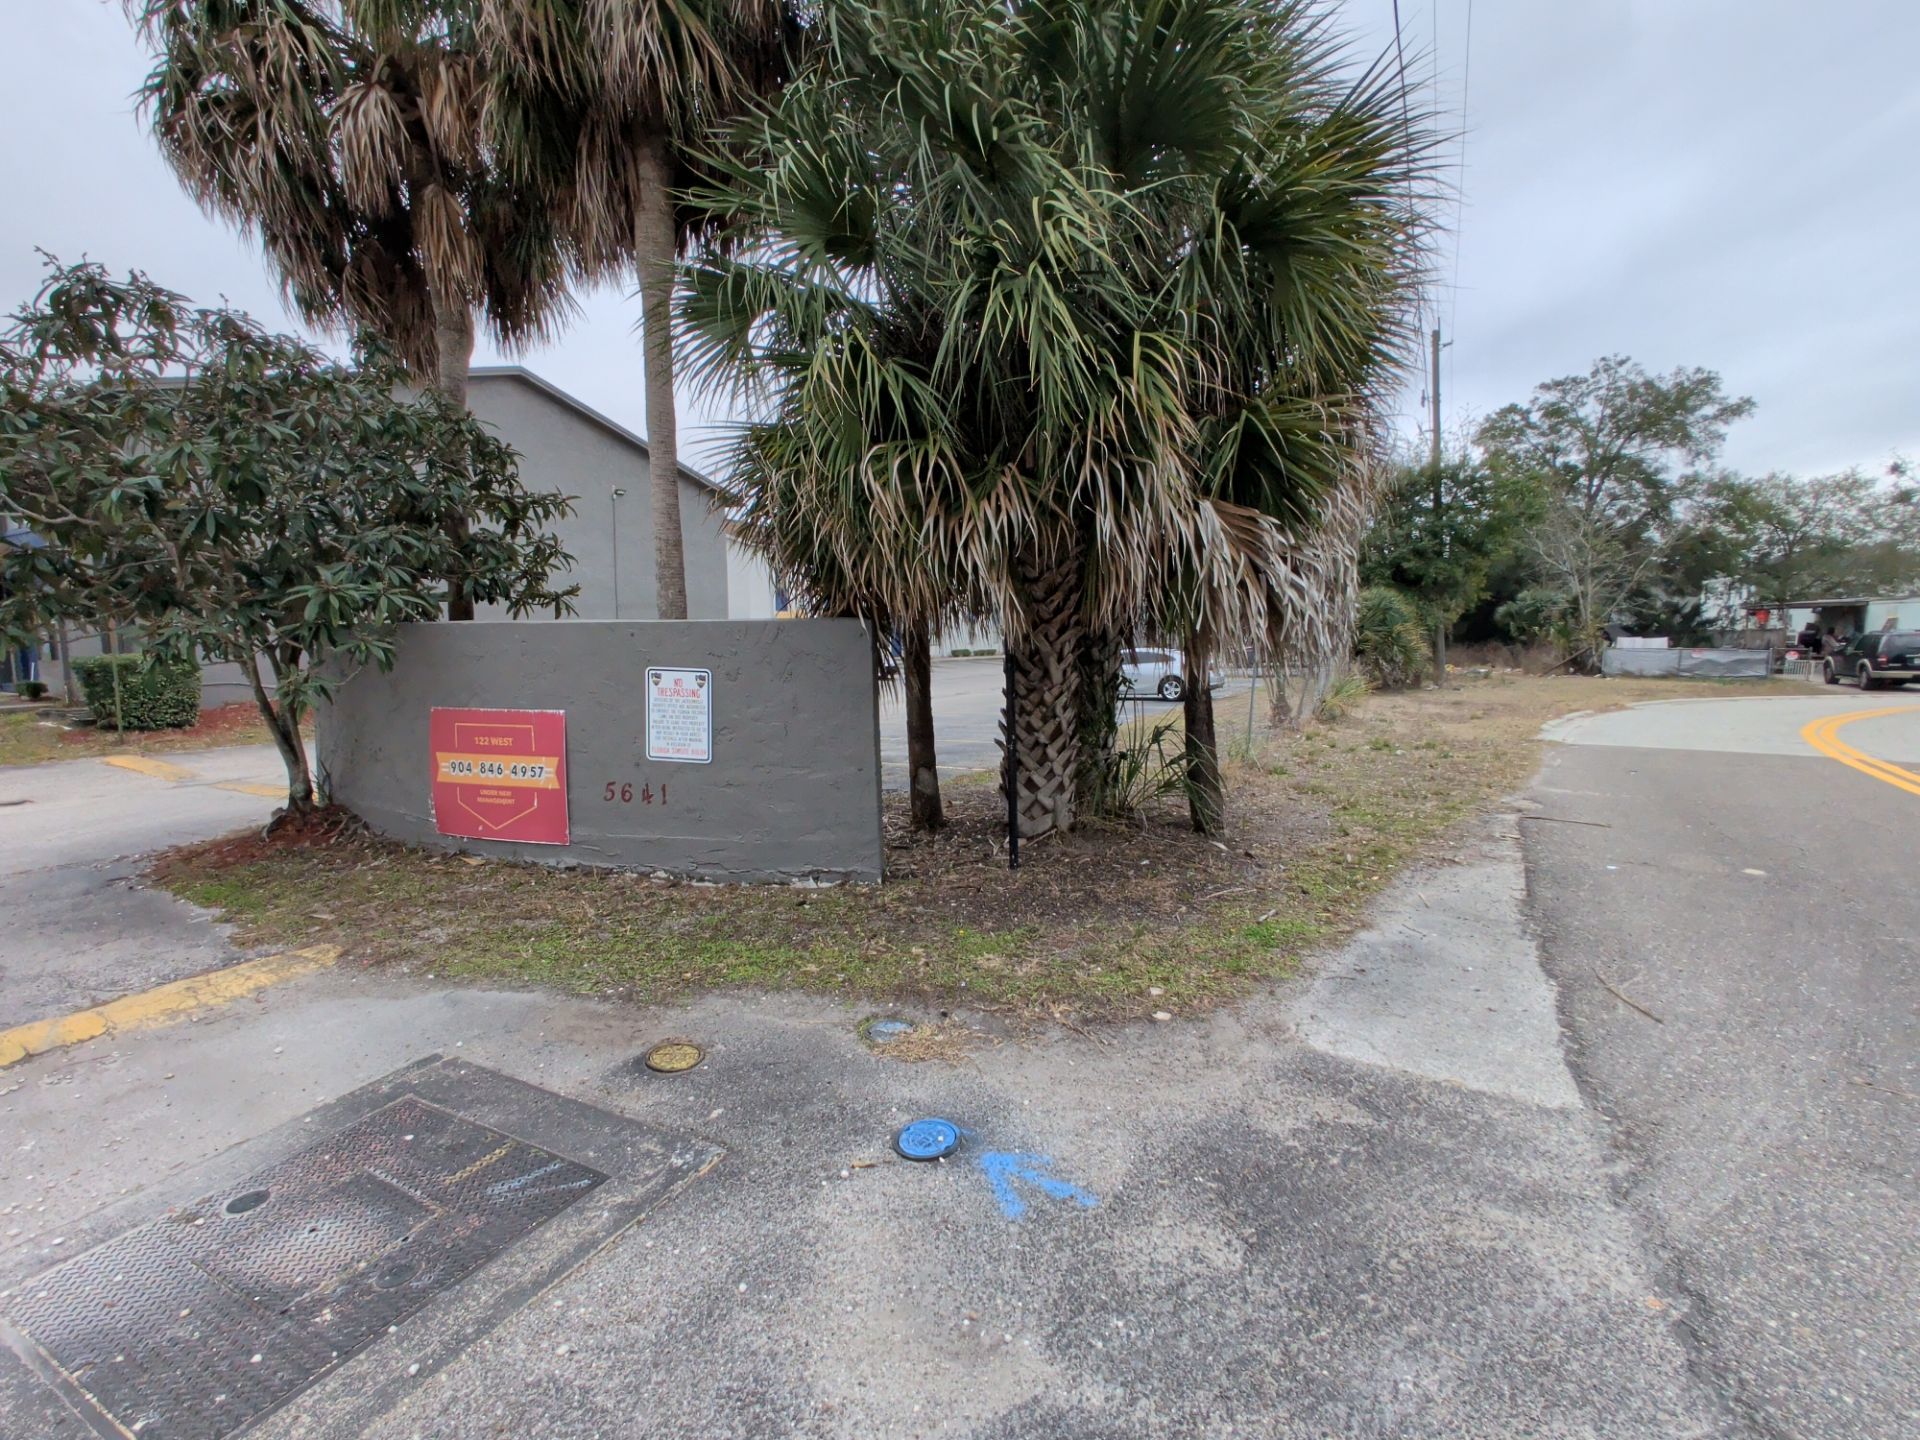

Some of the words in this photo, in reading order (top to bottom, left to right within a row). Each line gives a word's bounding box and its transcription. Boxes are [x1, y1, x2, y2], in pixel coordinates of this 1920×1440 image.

[673, 678, 683, 687] NO
[657, 687, 701, 698] TRESPASSING
[474, 736, 489, 746] 122
[490, 737, 513, 746] WEST
[450, 761, 472, 774] 904
[480, 762, 503, 775] 846
[511, 765, 544, 778] 4957
[603, 780, 667, 806] 5641
